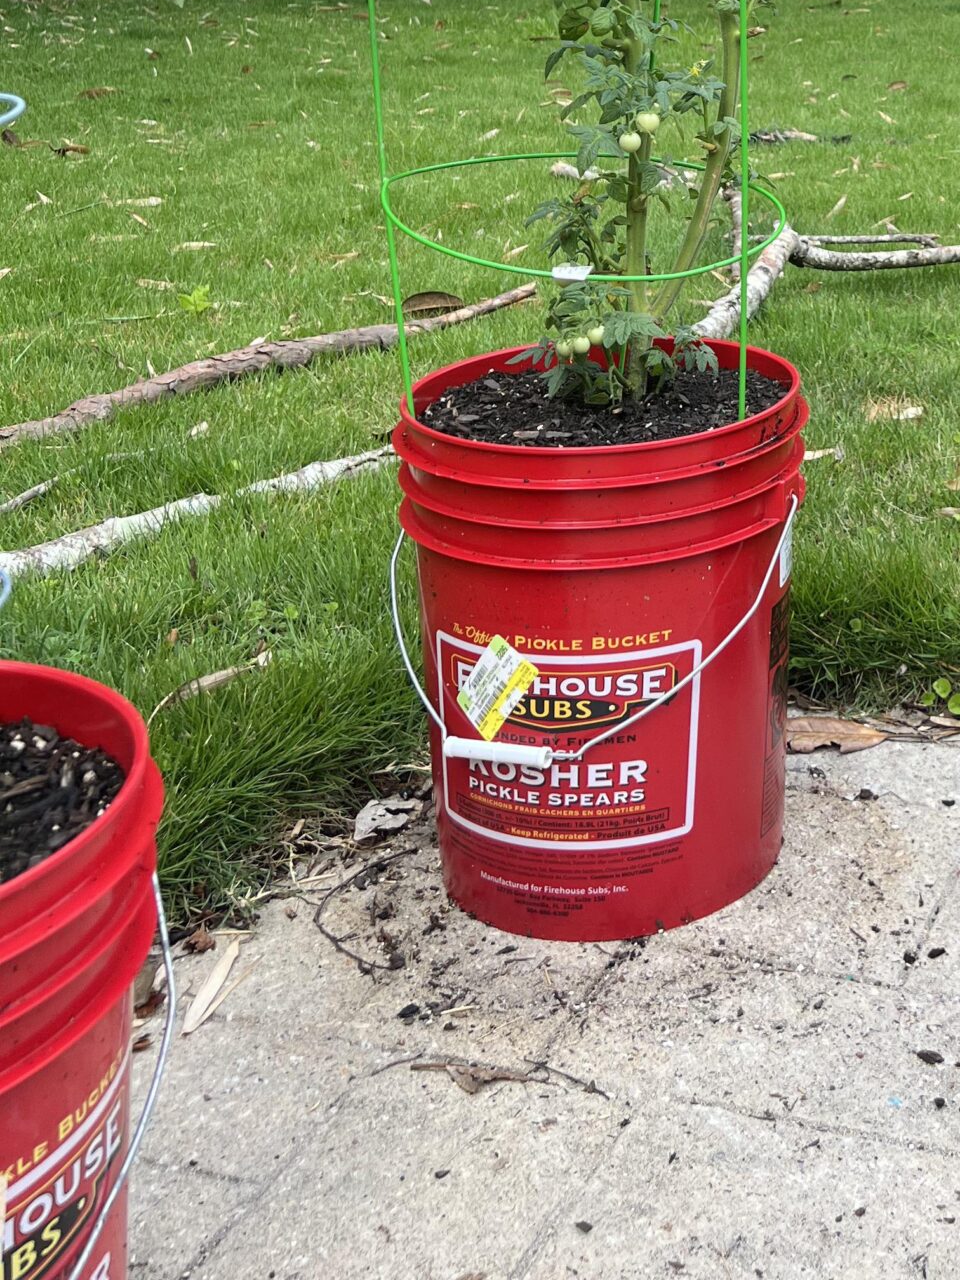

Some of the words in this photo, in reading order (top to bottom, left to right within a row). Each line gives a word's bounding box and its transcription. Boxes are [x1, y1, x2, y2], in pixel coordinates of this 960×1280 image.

[591, 629, 673, 651] BUCKET
[512, 699, 593, 719] SUBS
[542, 734, 560, 746] BY
[468, 758, 649, 789] KOSHER
[468, 776, 541, 805] PICKLE
[547, 788, 646, 807] SPEARS
[514, 804, 539, 815] FRAIS
[539, 807, 580, 816] CACHERS
[581, 808, 594, 816] EN
[595, 804, 647, 816] QUARTIERS
[511, 826, 532, 838] Keep
[532, 828, 590, 841] Refrigerated
[633, 827, 646, 836] de
[647, 823, 667, 833] USA
[479, 870, 530, 892] Manufactured
[530, 883, 543, 894] for
[543, 884, 587, 896] Firehouse
[587, 884, 612, 897] Subs,
[613, 883, 630, 894] Inc.
